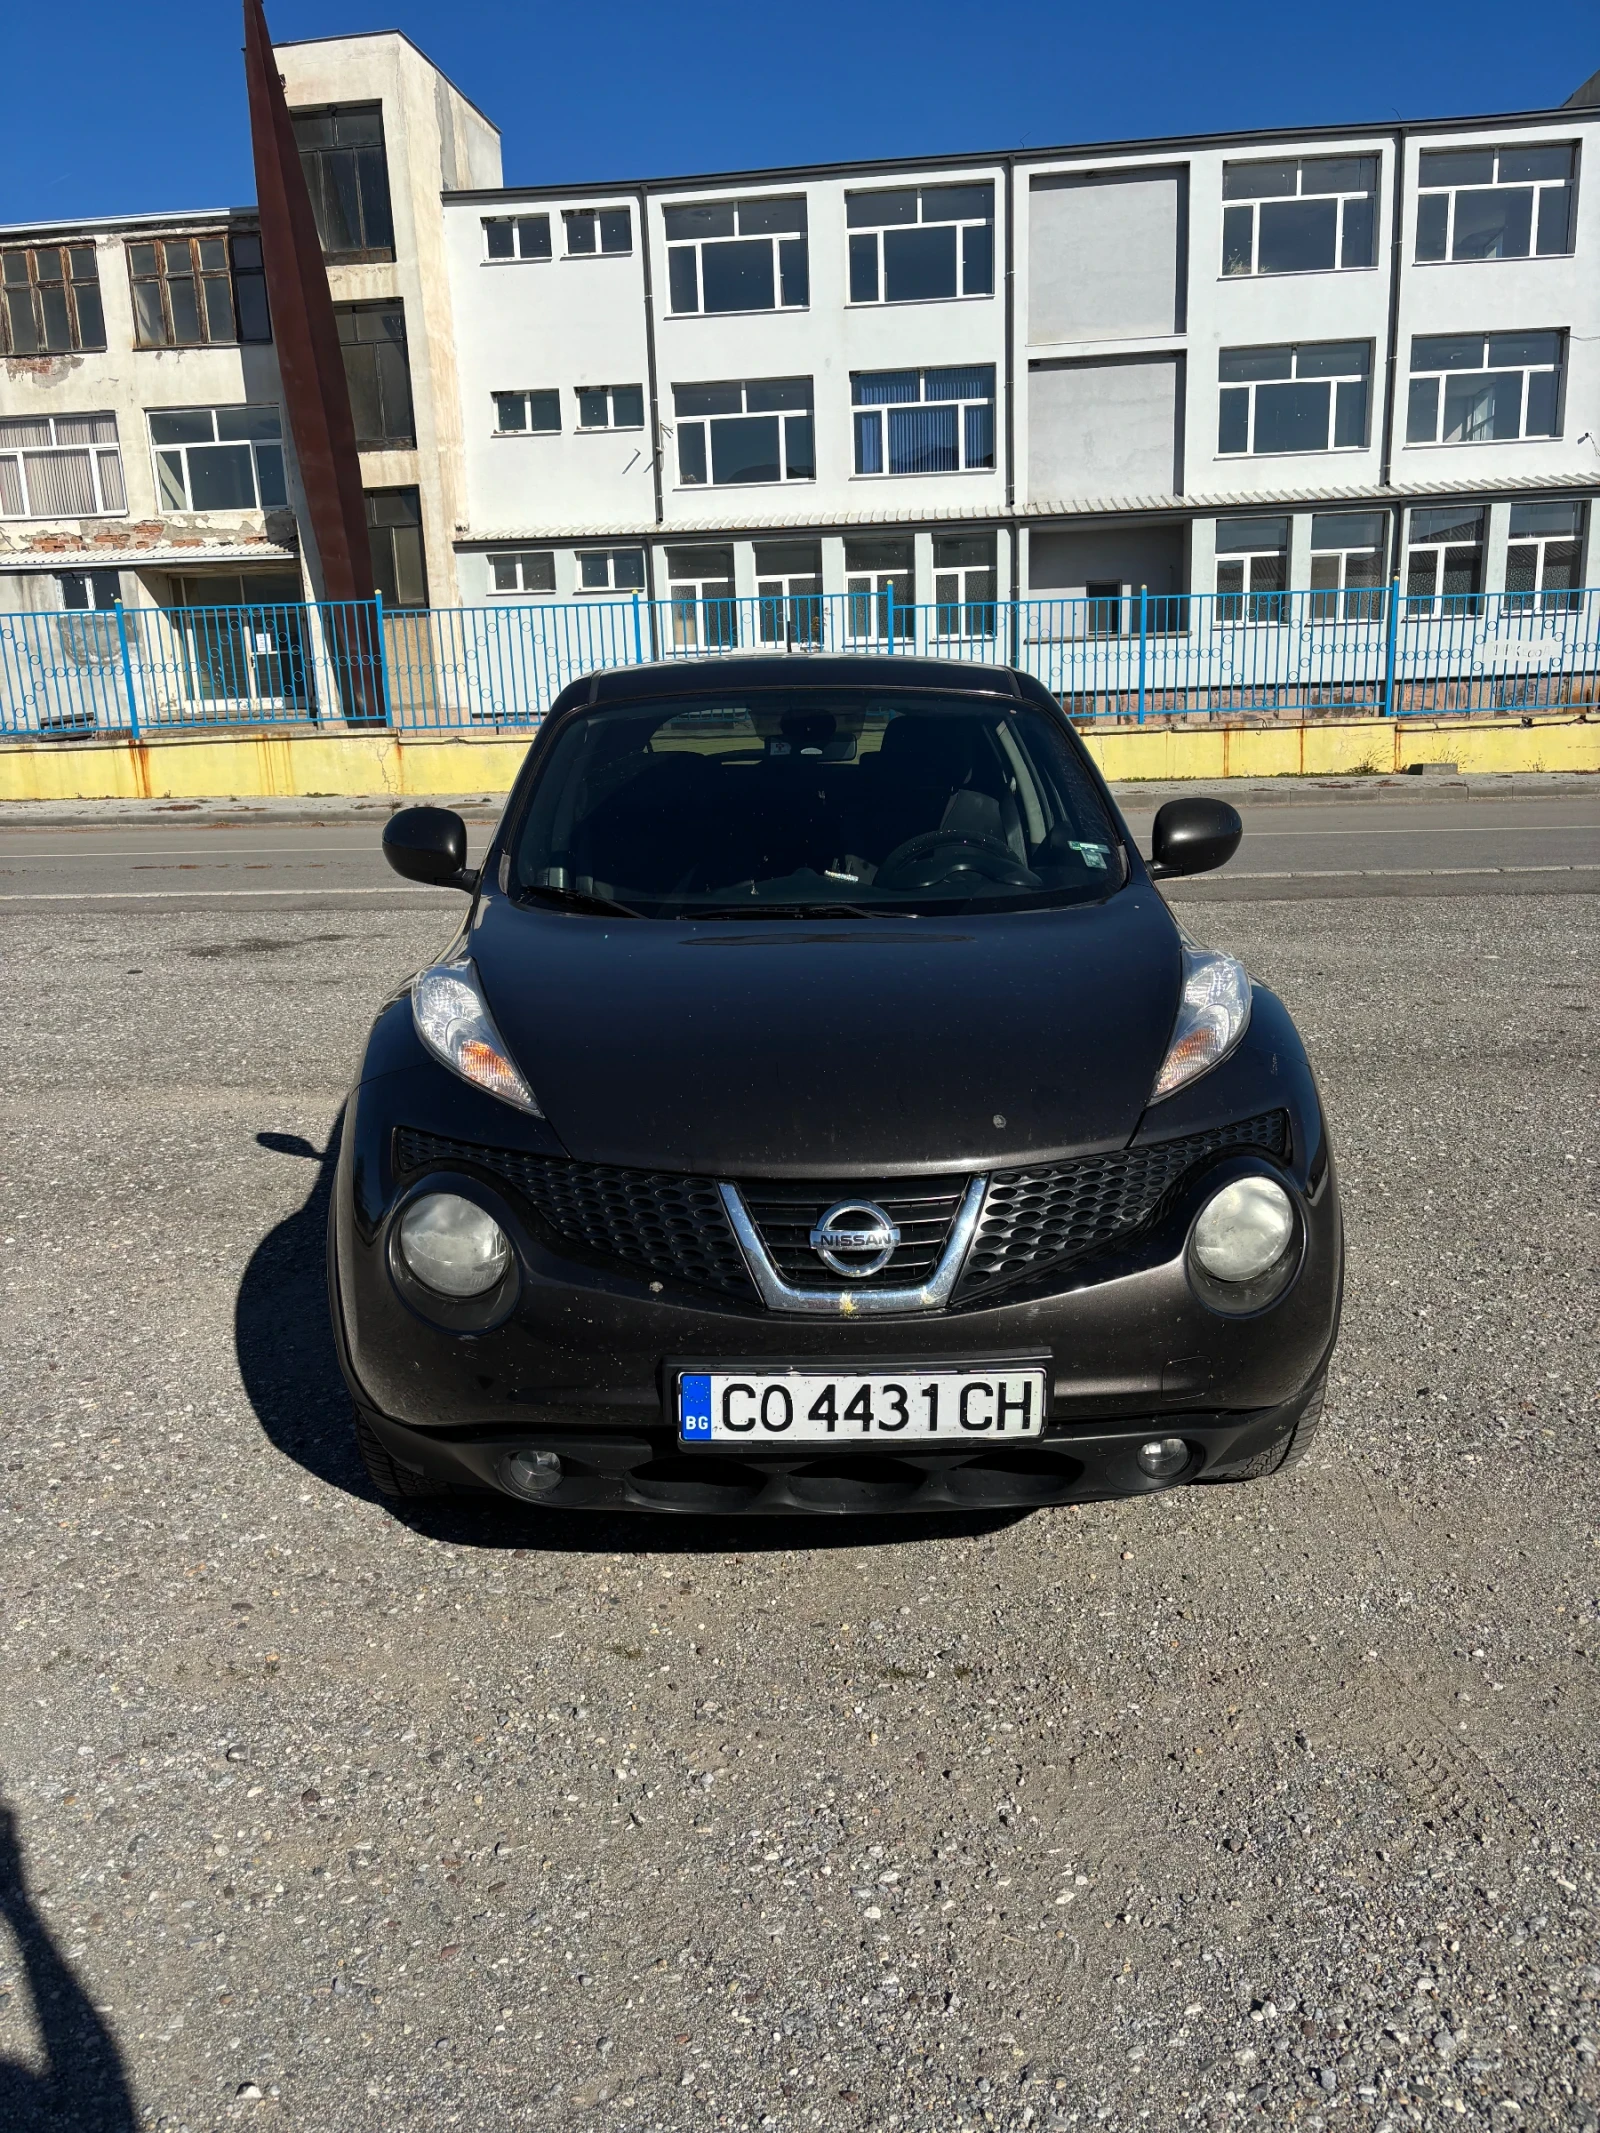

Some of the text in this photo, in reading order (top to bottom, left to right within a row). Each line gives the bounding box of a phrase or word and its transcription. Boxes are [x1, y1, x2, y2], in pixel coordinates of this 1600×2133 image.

[820, 1233, 891, 1246] NISSAN
[685, 1380, 1032, 1433] BG CO 4431 CH
